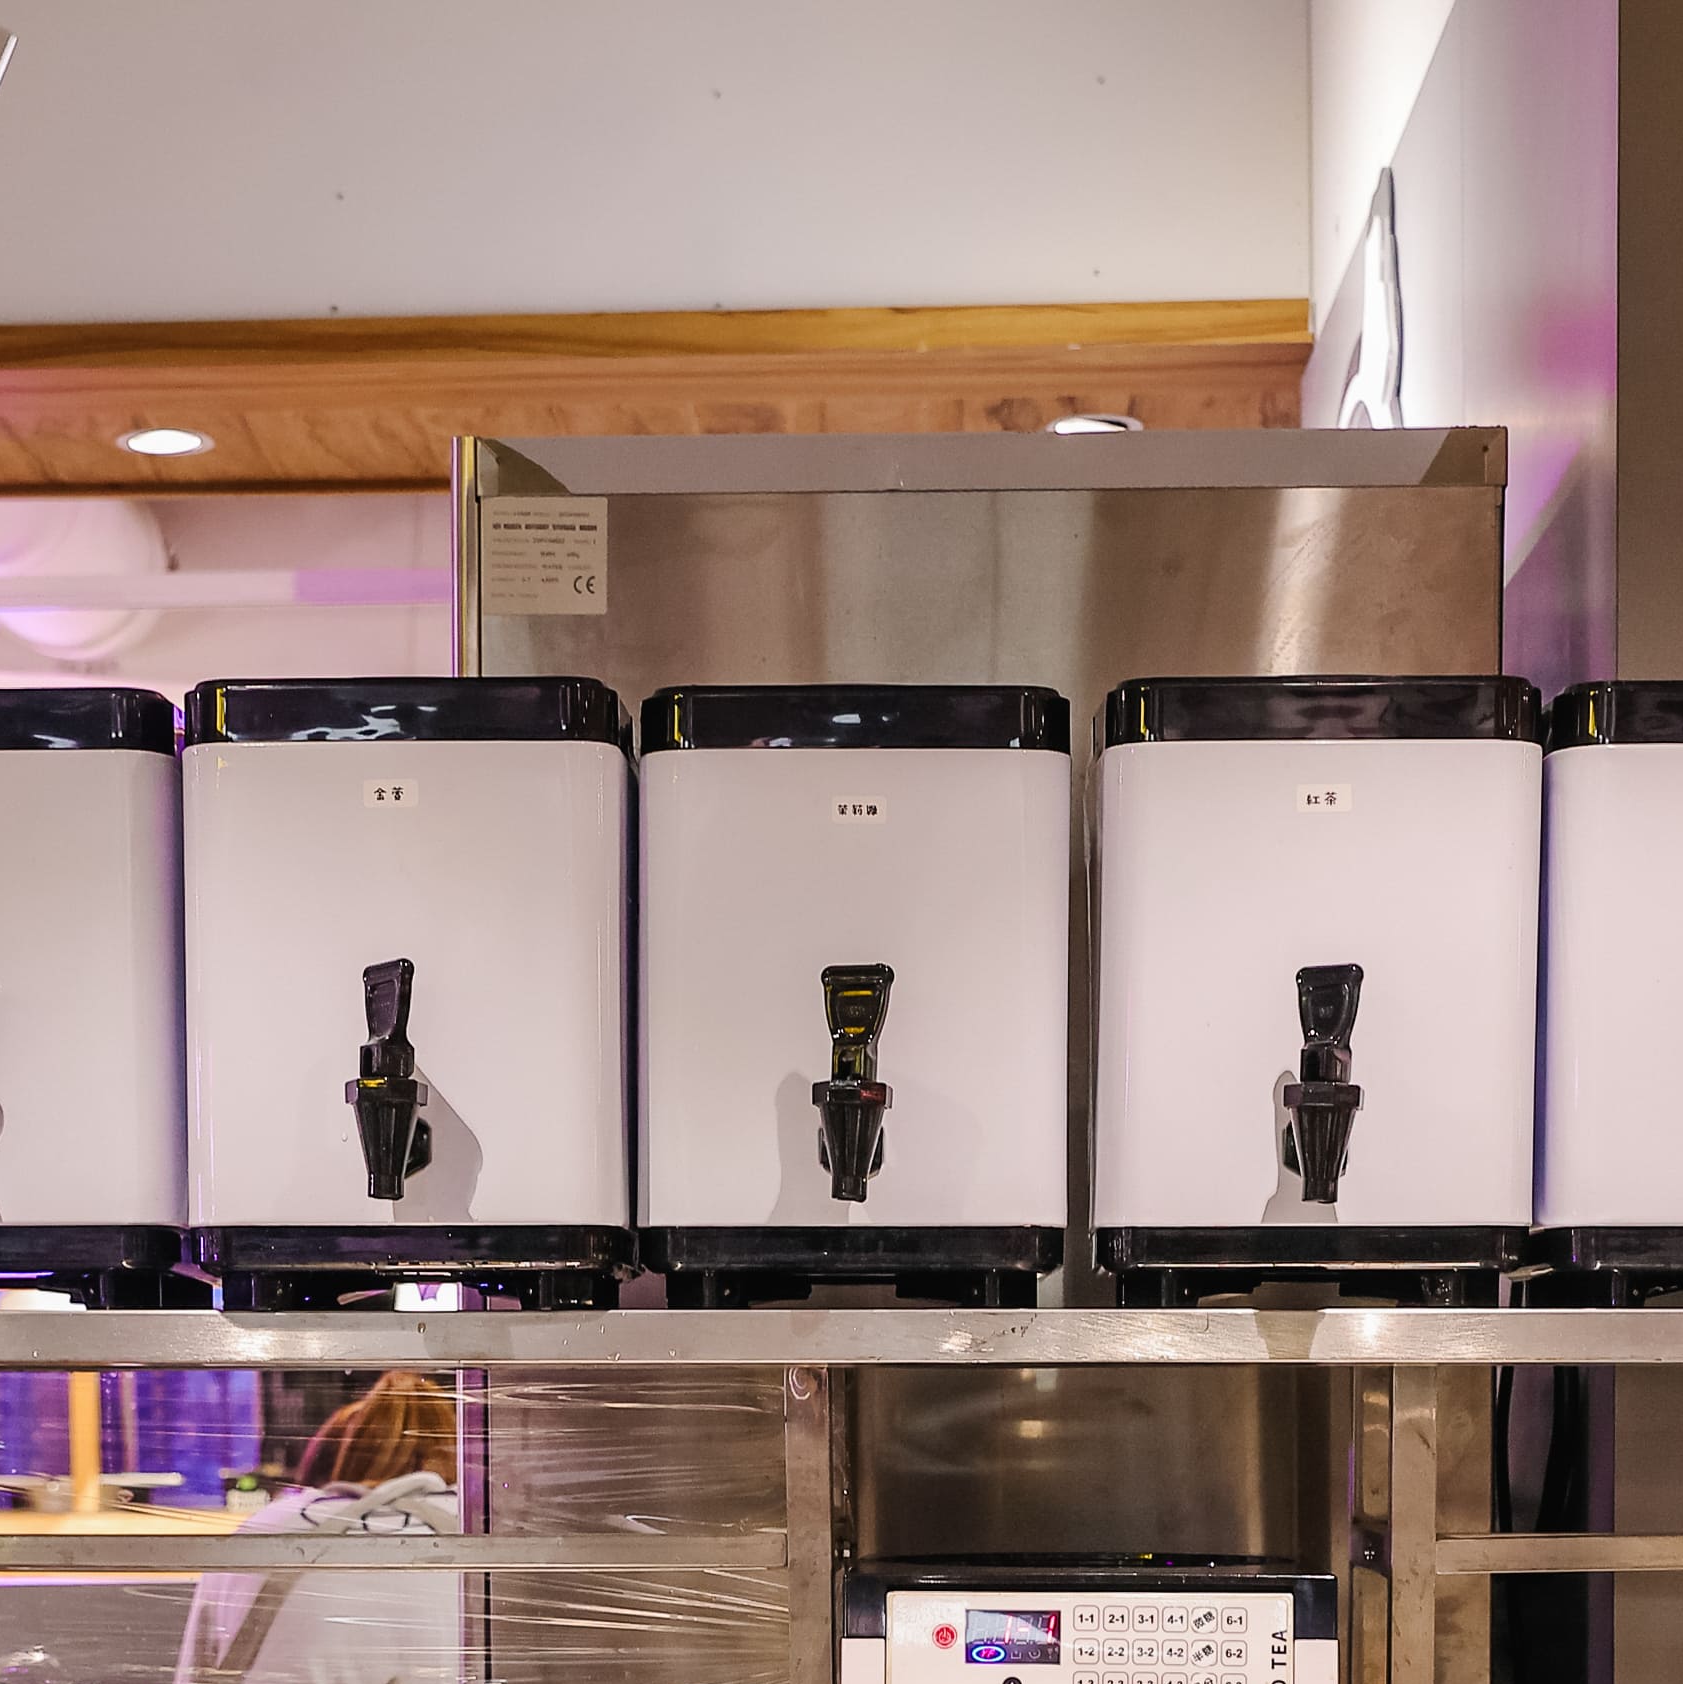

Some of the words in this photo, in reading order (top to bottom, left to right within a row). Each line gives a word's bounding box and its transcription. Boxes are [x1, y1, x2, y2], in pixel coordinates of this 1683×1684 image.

[1306, 792, 1338, 806] 紅茶
[1078, 1613, 1094, 1624] 1-1
[1108, 1614, 1125, 1624] 2-1
[1138, 1614, 1154, 1624] 3-1
[1167, 1615, 1184, 1625] 4-1
[1226, 1616, 1243, 1625] 6-1
[1078, 1646, 1095, 1656] 1-2
[1108, 1647, 1125, 1657] 2-2
[1137, 1647, 1154, 1657] 3-2
[1166, 1648, 1184, 1658] 4-2
[1225, 1648, 1243, 1658] 6-2
[1271, 1630, 1287, 1670] TEA
